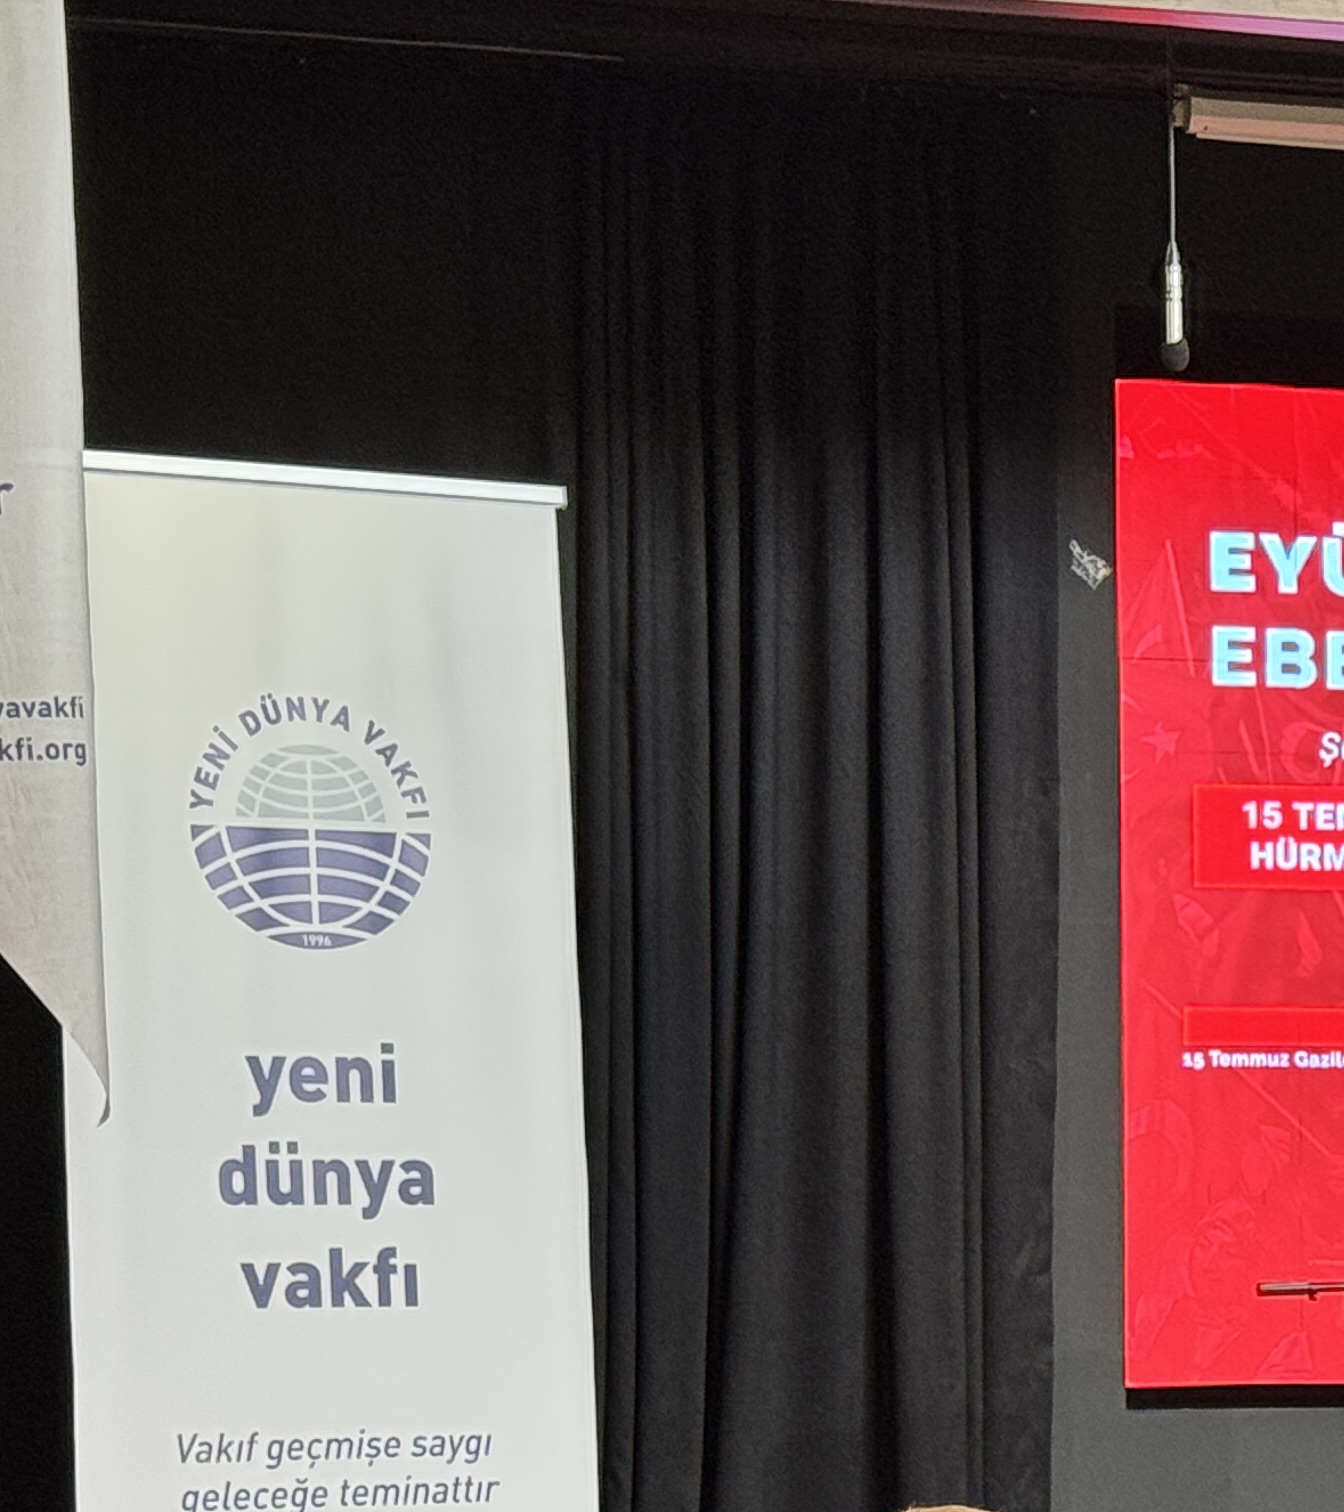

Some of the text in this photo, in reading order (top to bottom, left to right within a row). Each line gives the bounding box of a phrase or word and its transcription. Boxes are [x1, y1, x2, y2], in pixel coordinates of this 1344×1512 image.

[189, 693, 430, 819] YENİ DÜNYA VAKFI
[1242, 801, 1283, 830] 15
[245, 1042, 399, 1117] yeni
[1182, 1053, 1205, 1071] 15
[1209, 1050, 1290, 1069] Temmuz
[219, 1141, 435, 1219] dünya
[240, 1247, 420, 1309] vakfı
[177, 1429, 492, 1469] Vakıf geçmişe saygı
[340, 1475, 500, 1506] teminattır
